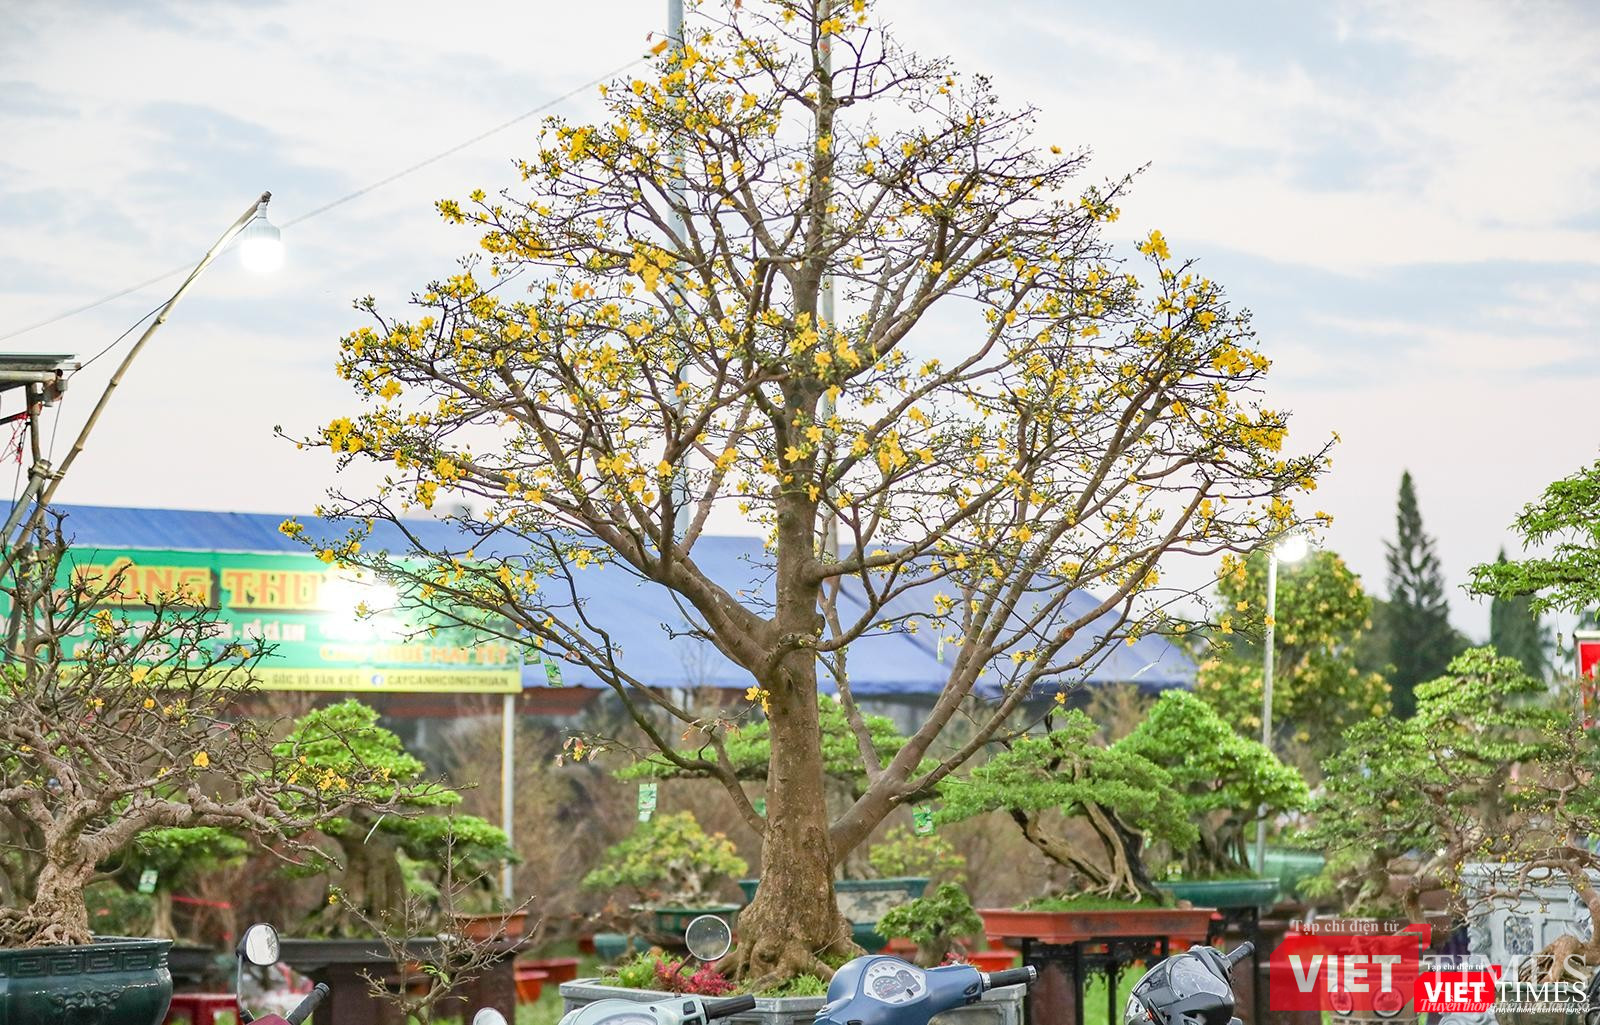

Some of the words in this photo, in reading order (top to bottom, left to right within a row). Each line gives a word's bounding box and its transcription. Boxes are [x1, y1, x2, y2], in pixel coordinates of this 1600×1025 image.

[72, 556, 211, 606] CÔNG
[222, 567, 345, 611] THU
[387, 673, 509, 686] CAYCANHCONGTHUAN
